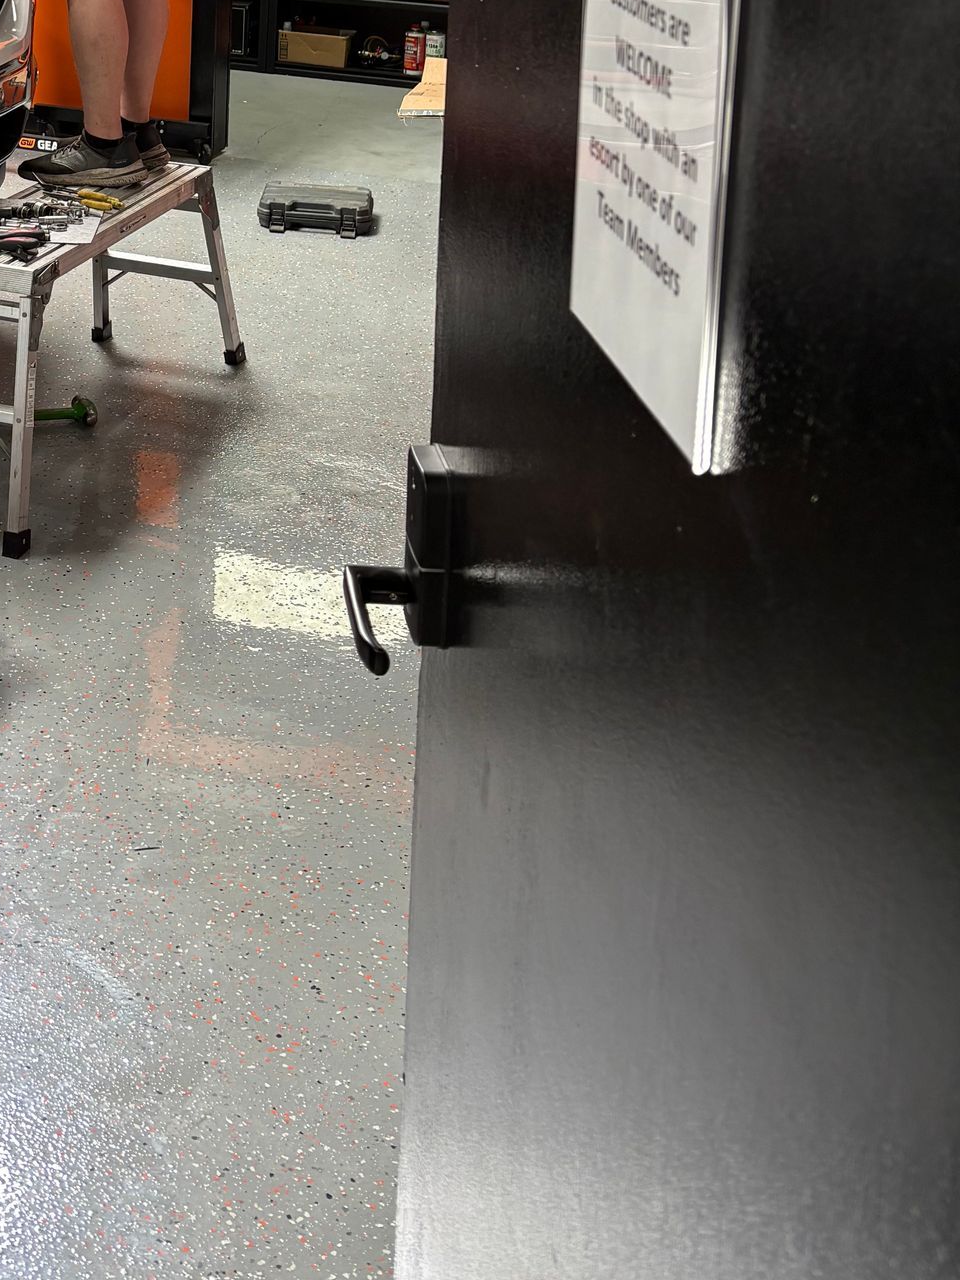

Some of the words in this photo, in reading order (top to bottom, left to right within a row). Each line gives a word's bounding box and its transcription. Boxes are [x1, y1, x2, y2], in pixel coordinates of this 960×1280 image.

[614, 35, 674, 100] WELCOME
[667, 12, 692, 47] are
[592, 73, 604, 108] in
[604, 84, 623, 122] the
[623, 100, 650, 150] shop
[651, 121, 681, 168] with
[681, 150, 700, 186] an
[589, 134, 621, 181] escort
[620, 159, 635, 198] by
[635, 173, 659, 213] one
[659, 188, 675, 226] of
[674, 213, 698, 248] our
[596, 190, 626, 245] Team
[625, 226, 682, 298] Members
